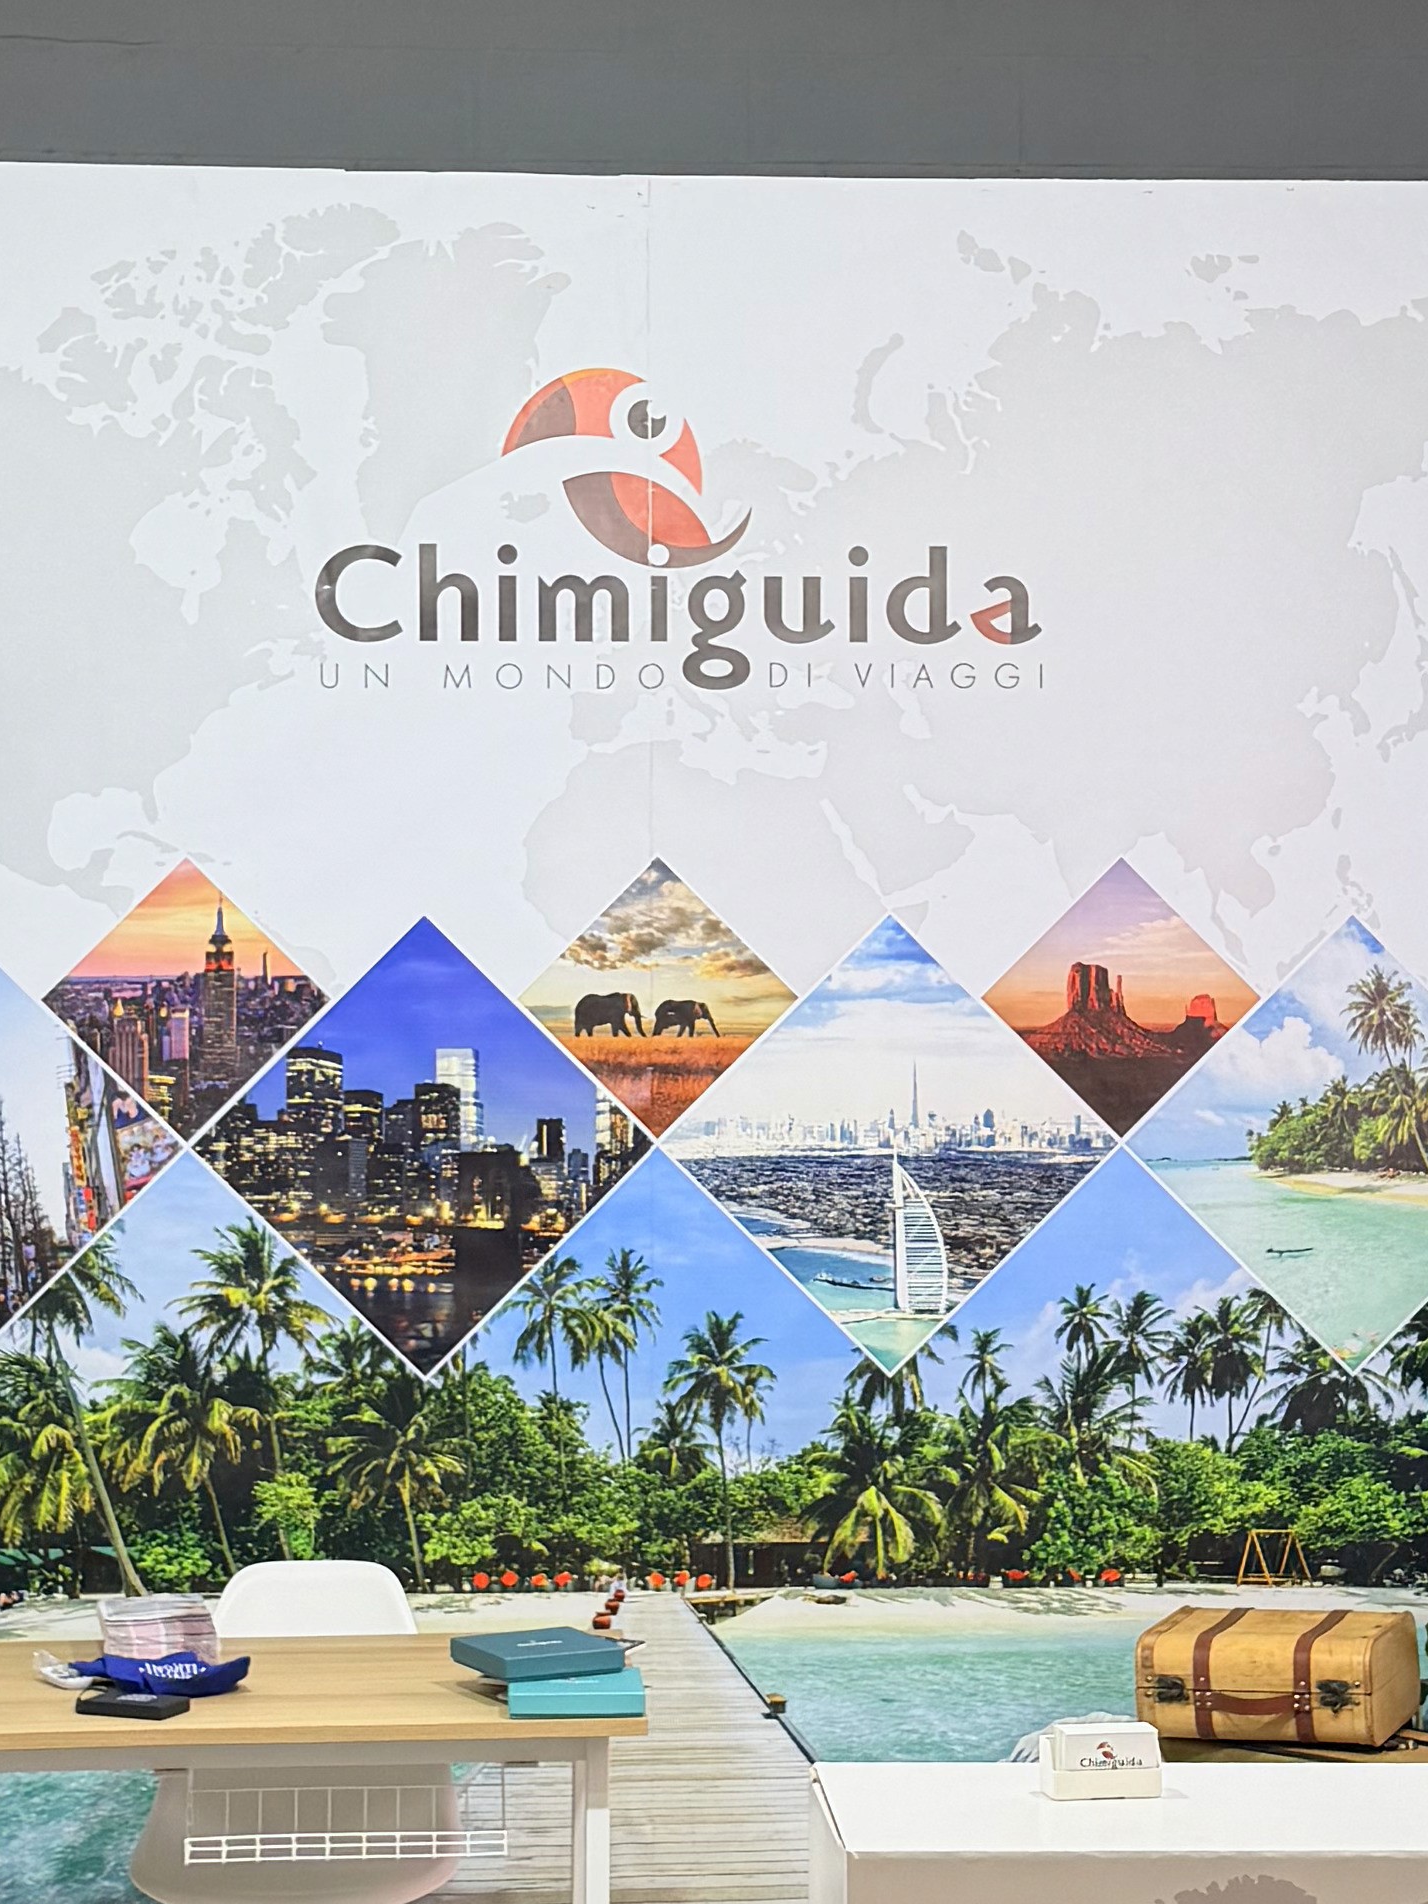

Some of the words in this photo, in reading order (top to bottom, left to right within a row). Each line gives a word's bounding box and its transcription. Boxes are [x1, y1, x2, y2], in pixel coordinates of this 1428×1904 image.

[314, 543, 1042, 690] Chimiguida
[319, 661, 391, 689] UN
[444, 662, 664, 689] MONDO
[769, 663, 814, 689] DI
[855, 663, 1046, 689] VIAGGI
